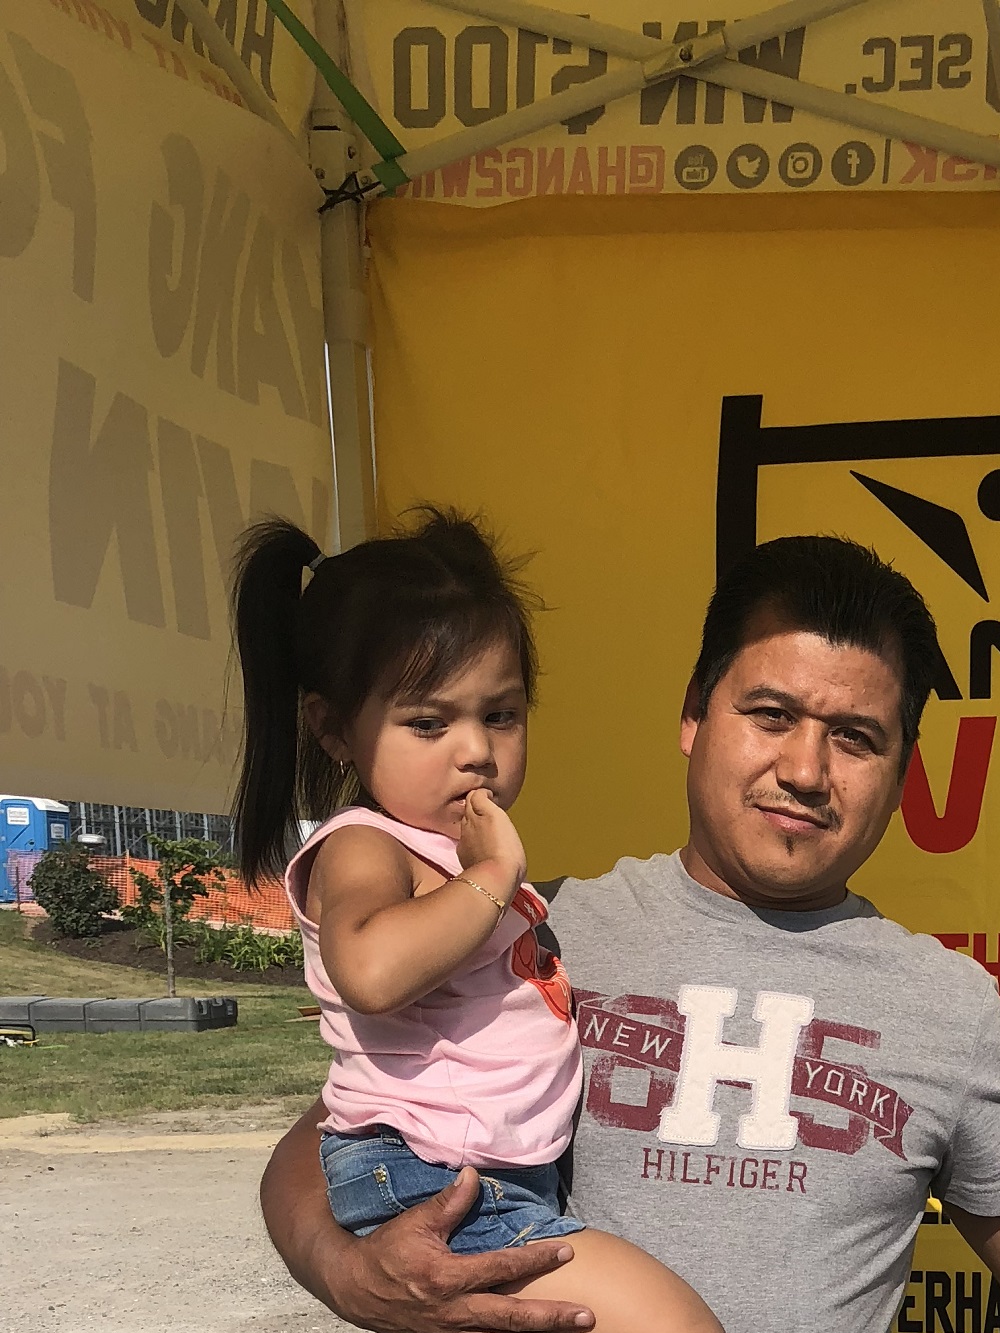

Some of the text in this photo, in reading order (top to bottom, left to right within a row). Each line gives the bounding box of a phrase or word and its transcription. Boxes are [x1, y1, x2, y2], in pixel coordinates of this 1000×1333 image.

[583, 1013, 893, 1119] NEW YORK
[656, 983, 816, 1151] H
[640, 1146, 809, 1195] HILFIGER
